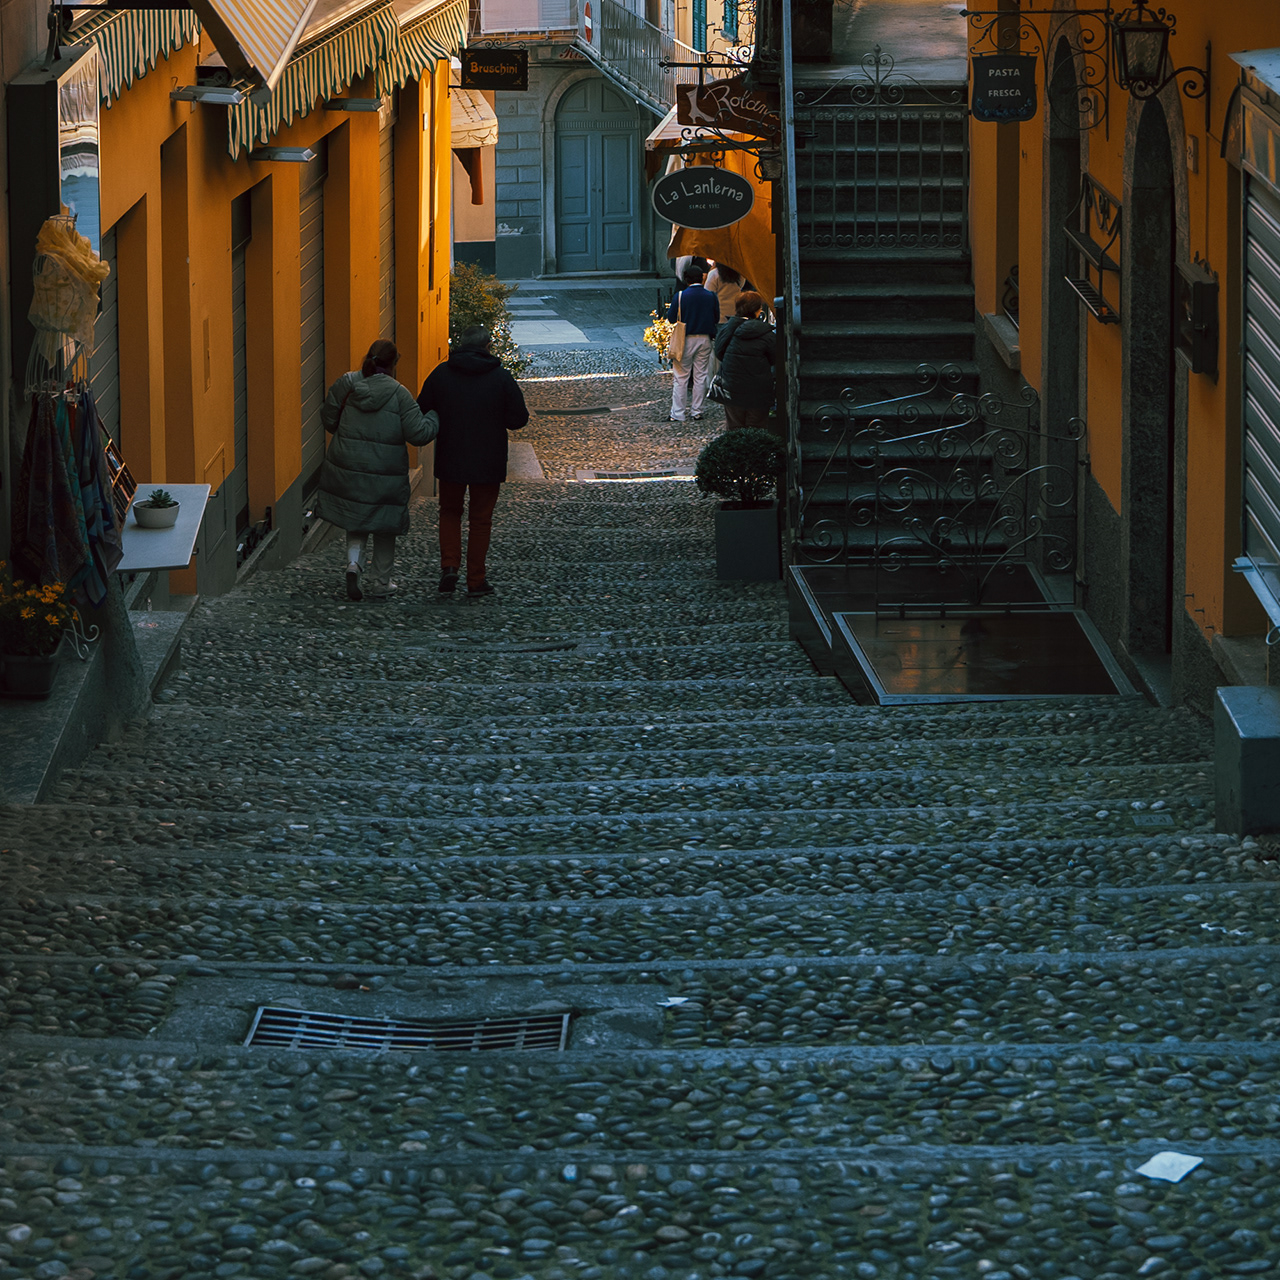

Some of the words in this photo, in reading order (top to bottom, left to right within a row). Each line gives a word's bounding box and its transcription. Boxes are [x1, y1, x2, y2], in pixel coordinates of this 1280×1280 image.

[470, 61, 518, 76] Bruschini
[988, 68, 1021, 77] PASTA
[988, 89, 1022, 97] FRESCA
[659, 190, 680, 205] La
[680, 177, 744, 202] Lanterna
